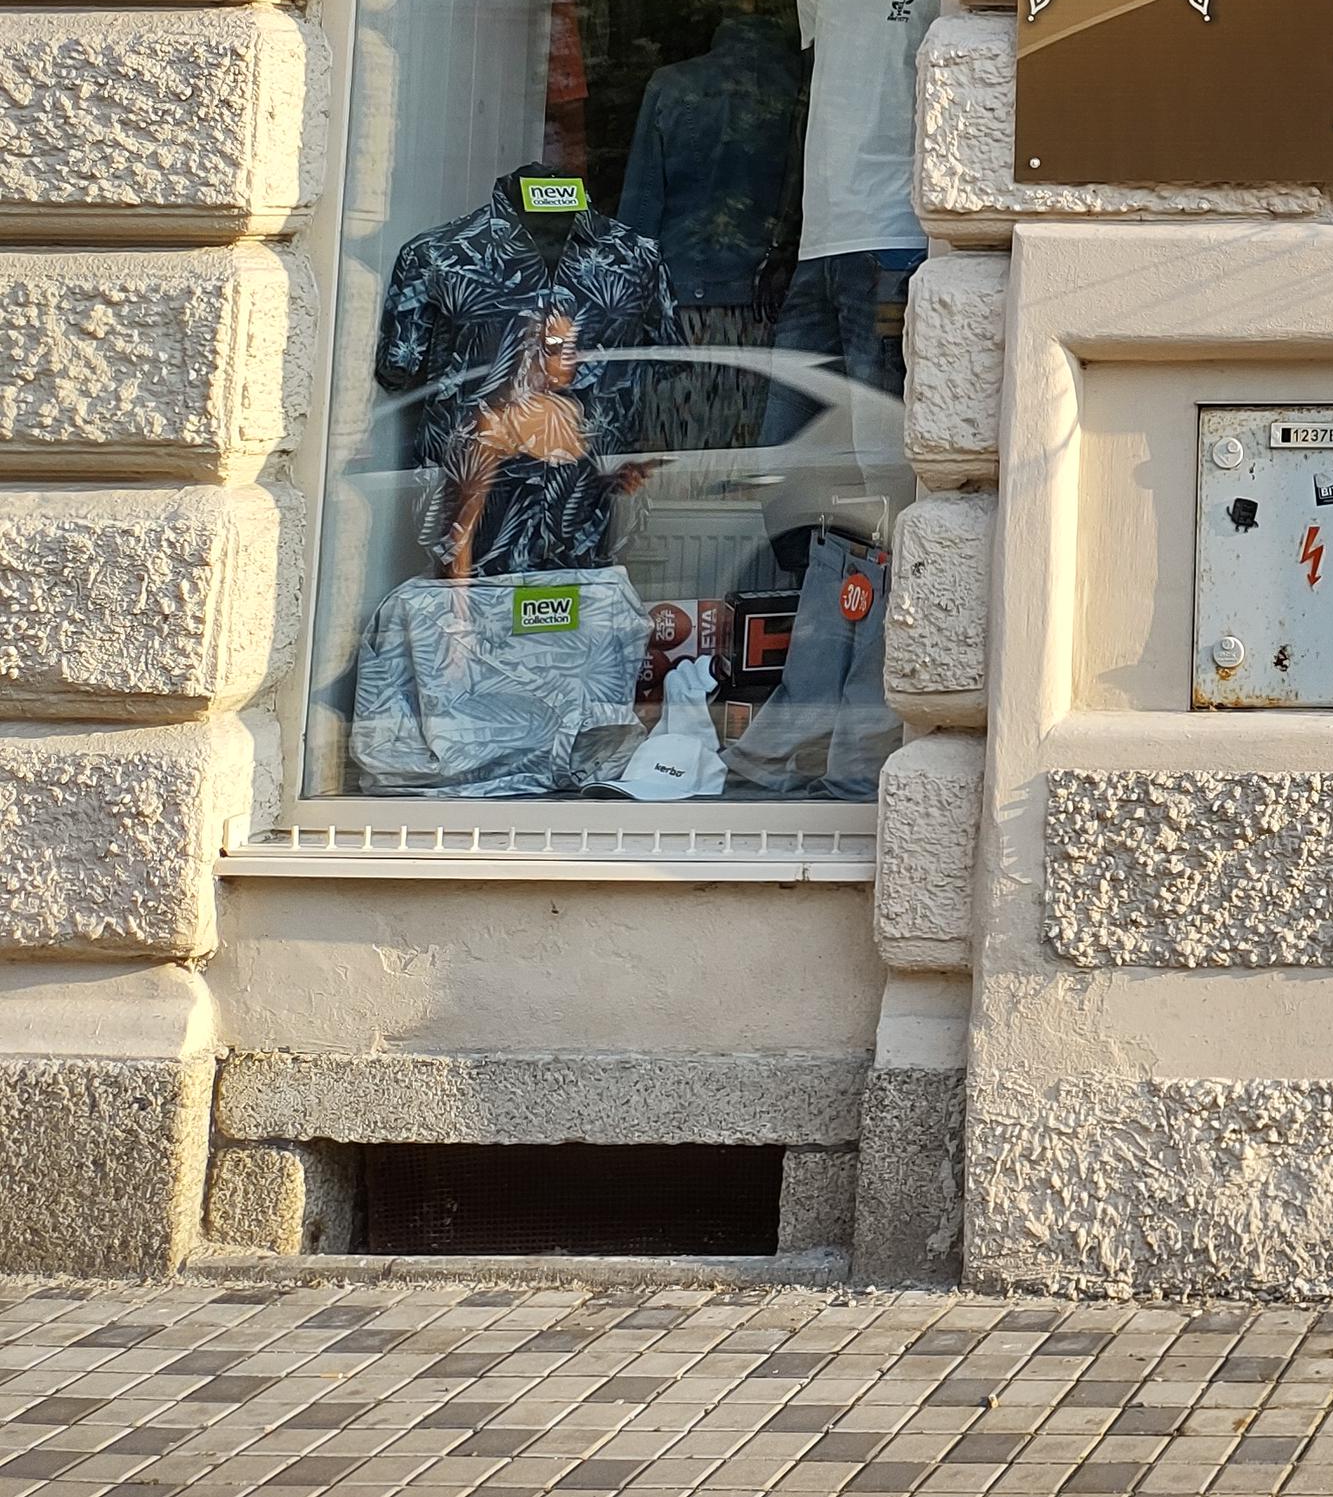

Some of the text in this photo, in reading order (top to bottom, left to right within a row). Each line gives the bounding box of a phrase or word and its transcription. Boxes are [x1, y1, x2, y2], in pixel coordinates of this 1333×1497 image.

[530, 186, 576, 198] new
[842, 583, 868, 612] -30%
[523, 599, 570, 616] new
[523, 615, 569, 625] collection
[702, 608, 717, 655] EVA
